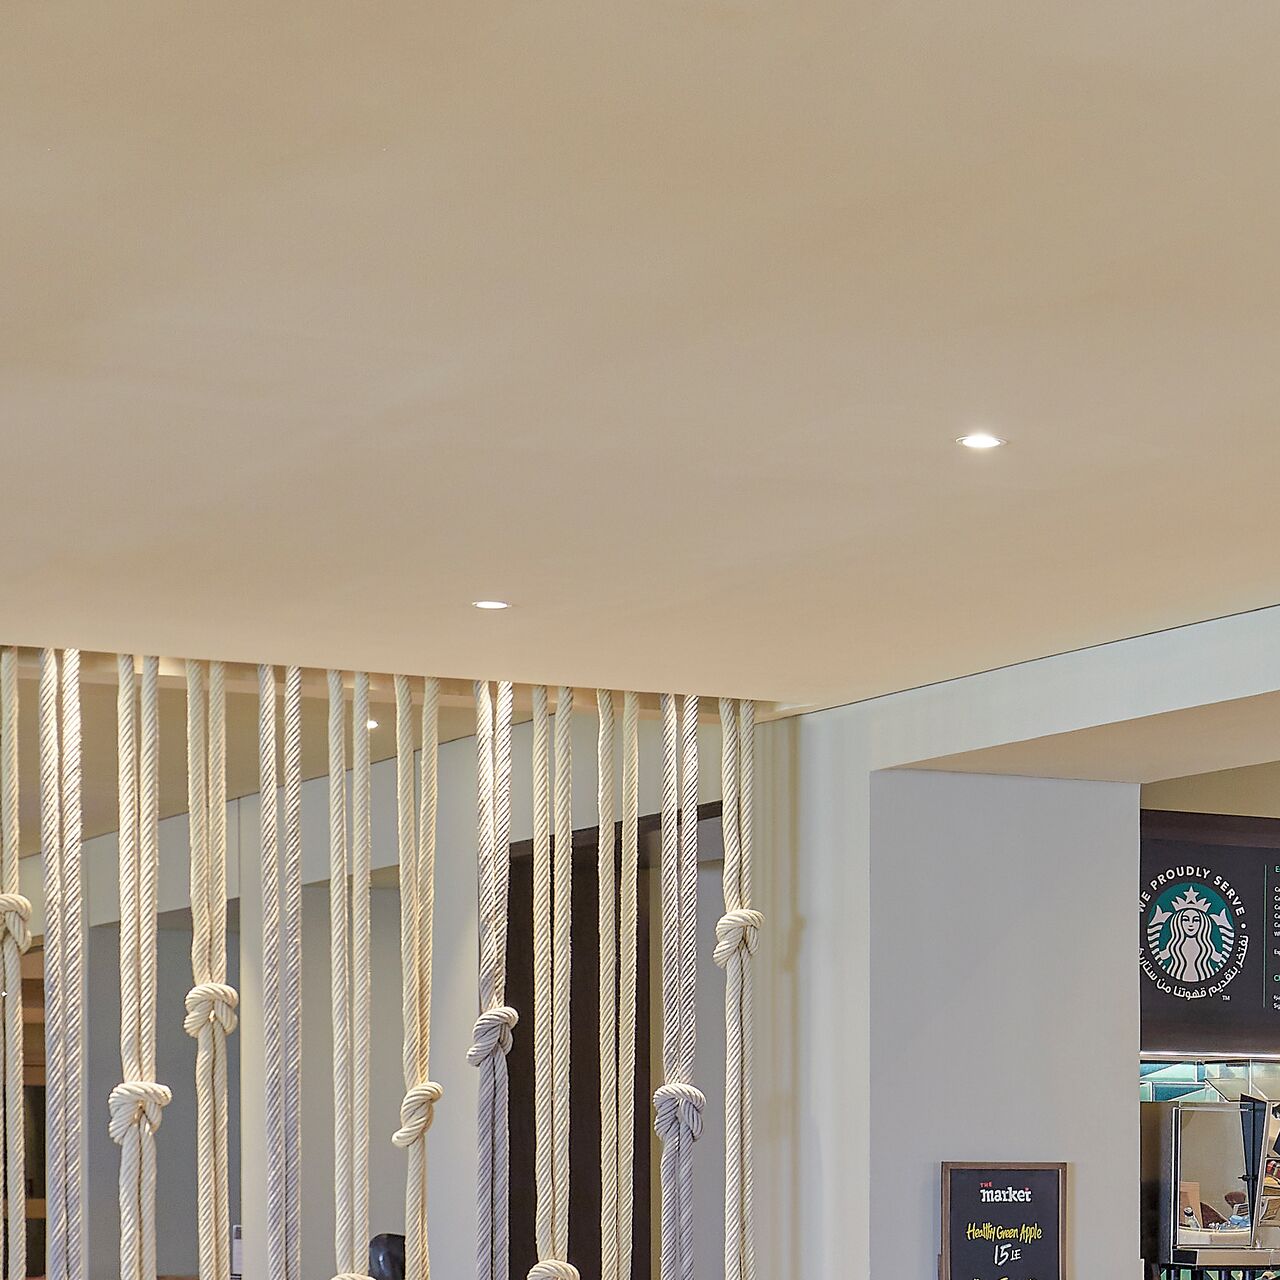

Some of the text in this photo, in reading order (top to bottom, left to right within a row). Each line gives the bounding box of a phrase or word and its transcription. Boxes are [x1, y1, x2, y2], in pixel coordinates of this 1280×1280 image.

[1150, 866, 1211, 891] PROUDLY
[1213, 875, 1246, 917] SERVE
[979, 1187, 1032, 1203] market
[966, 1221, 1042, 1244] Healthy Green Apple
[994, 1243, 1022, 1266] 15 LE
